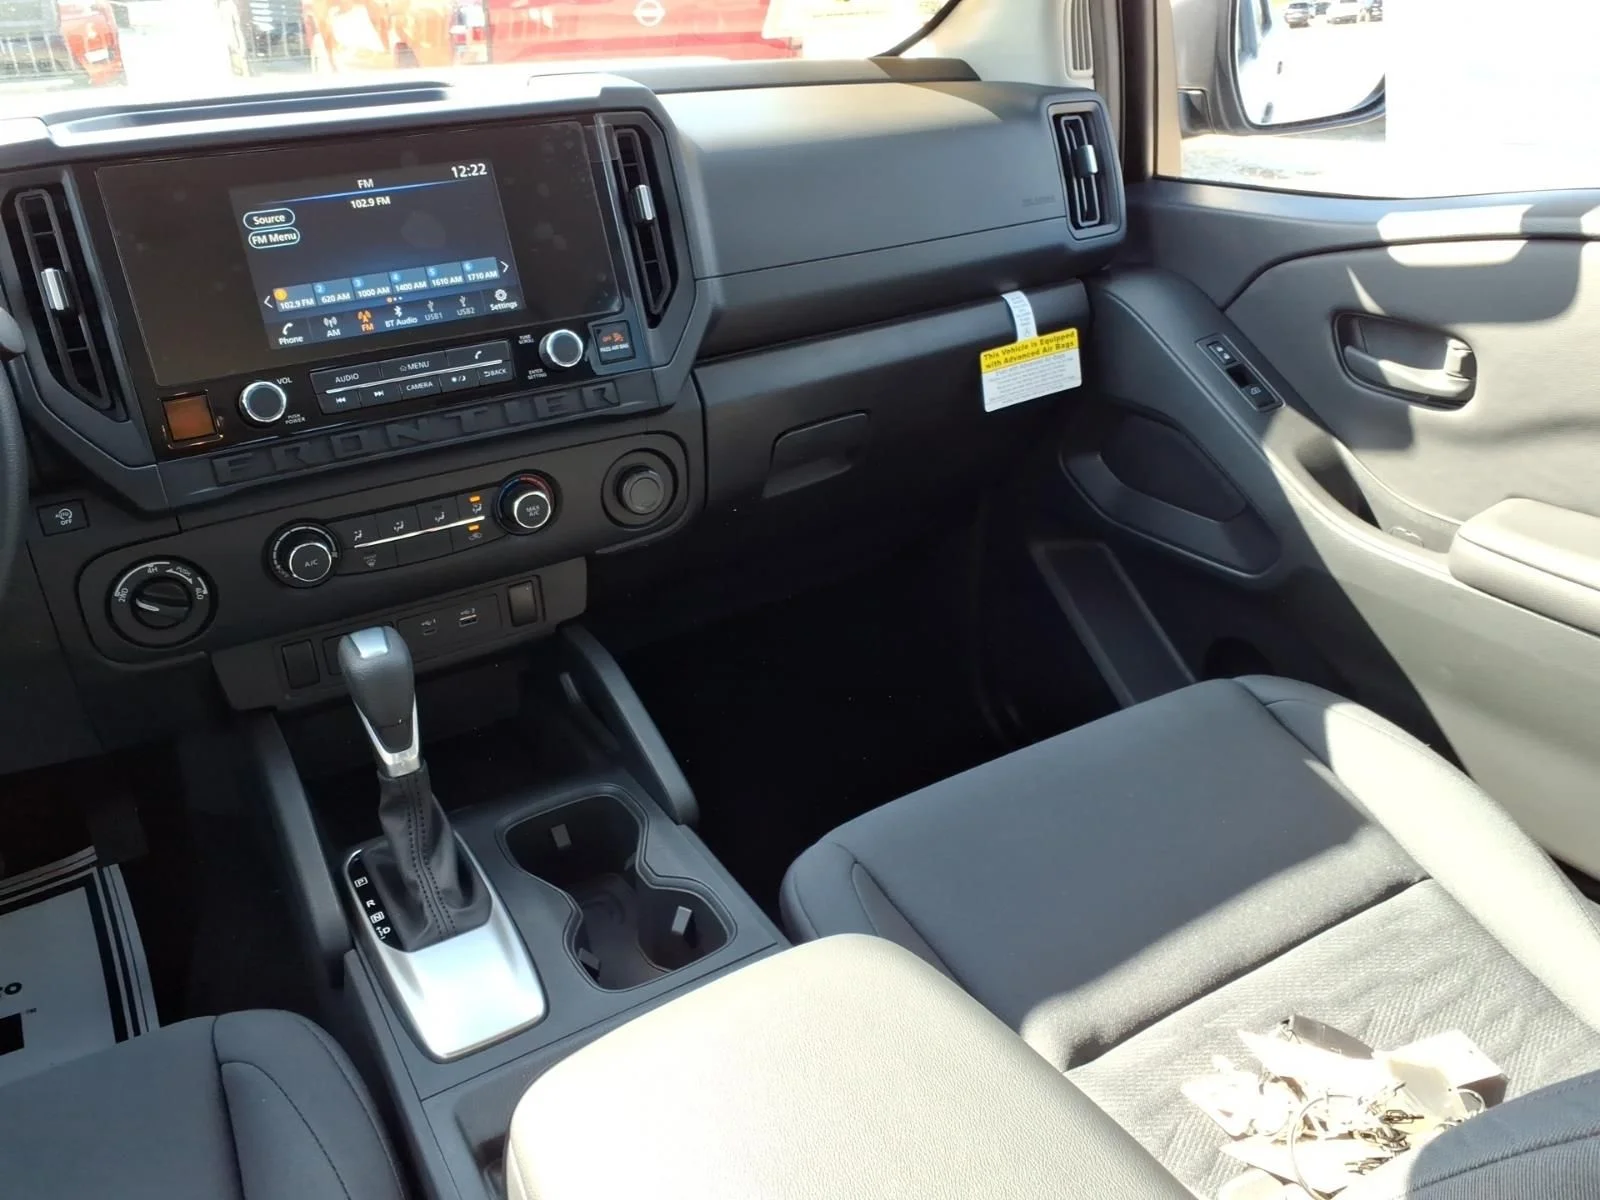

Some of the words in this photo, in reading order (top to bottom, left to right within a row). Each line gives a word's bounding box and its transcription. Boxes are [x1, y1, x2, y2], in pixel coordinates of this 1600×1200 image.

[451, 163, 487, 178] 12:22
[357, 179, 374, 189] FM
[350, 198, 375, 209] 102.9
[376, 196, 391, 206] FM
[252, 214, 286, 225] Source
[251, 234, 268, 245] FM
[269, 232, 297, 243] Menu
[449, 276, 463, 284] AM
[467, 272, 483, 281] 1710
[484, 270, 498, 279] AM
[413, 281, 427, 290] AM
[358, 289, 376, 298] 1000
[376, 286, 391, 295] AM
[321, 295, 336, 304] 620
[336, 292, 351, 301] AM
[280, 302, 301, 311] 102.9
[301, 298, 315, 307] FM
[490, 301, 518, 312] Settings
[424, 312, 443, 321] USB1
[456, 307, 475, 316] USB2
[385, 320, 395, 328] BT
[396, 316, 418, 326] Audio
[361, 323, 374, 332] FM
[326, 329, 341, 338] AM
[278, 336, 304, 345] Phone
[983, 352, 1000, 361] This
[1000, 344, 1029, 356] Vehicle
[1039, 331, 1075, 345] Equipped
[985, 360, 1002, 369] with
[1003, 349, 1041, 365] Advanced
[1041, 345, 1053, 354] Air
[1055, 341, 1075, 351] Bags
[407, 361, 430, 371] MENU
[491, 368, 507, 376] BACK
[335, 373, 360, 383] AUDIO
[406, 381, 433, 391] CAMERA
[212, 381, 620, 484] FRONTIER
[304, 558, 319, 567] A/C
[147, 566, 158, 574] 4H
[365, 899, 376, 908] R
